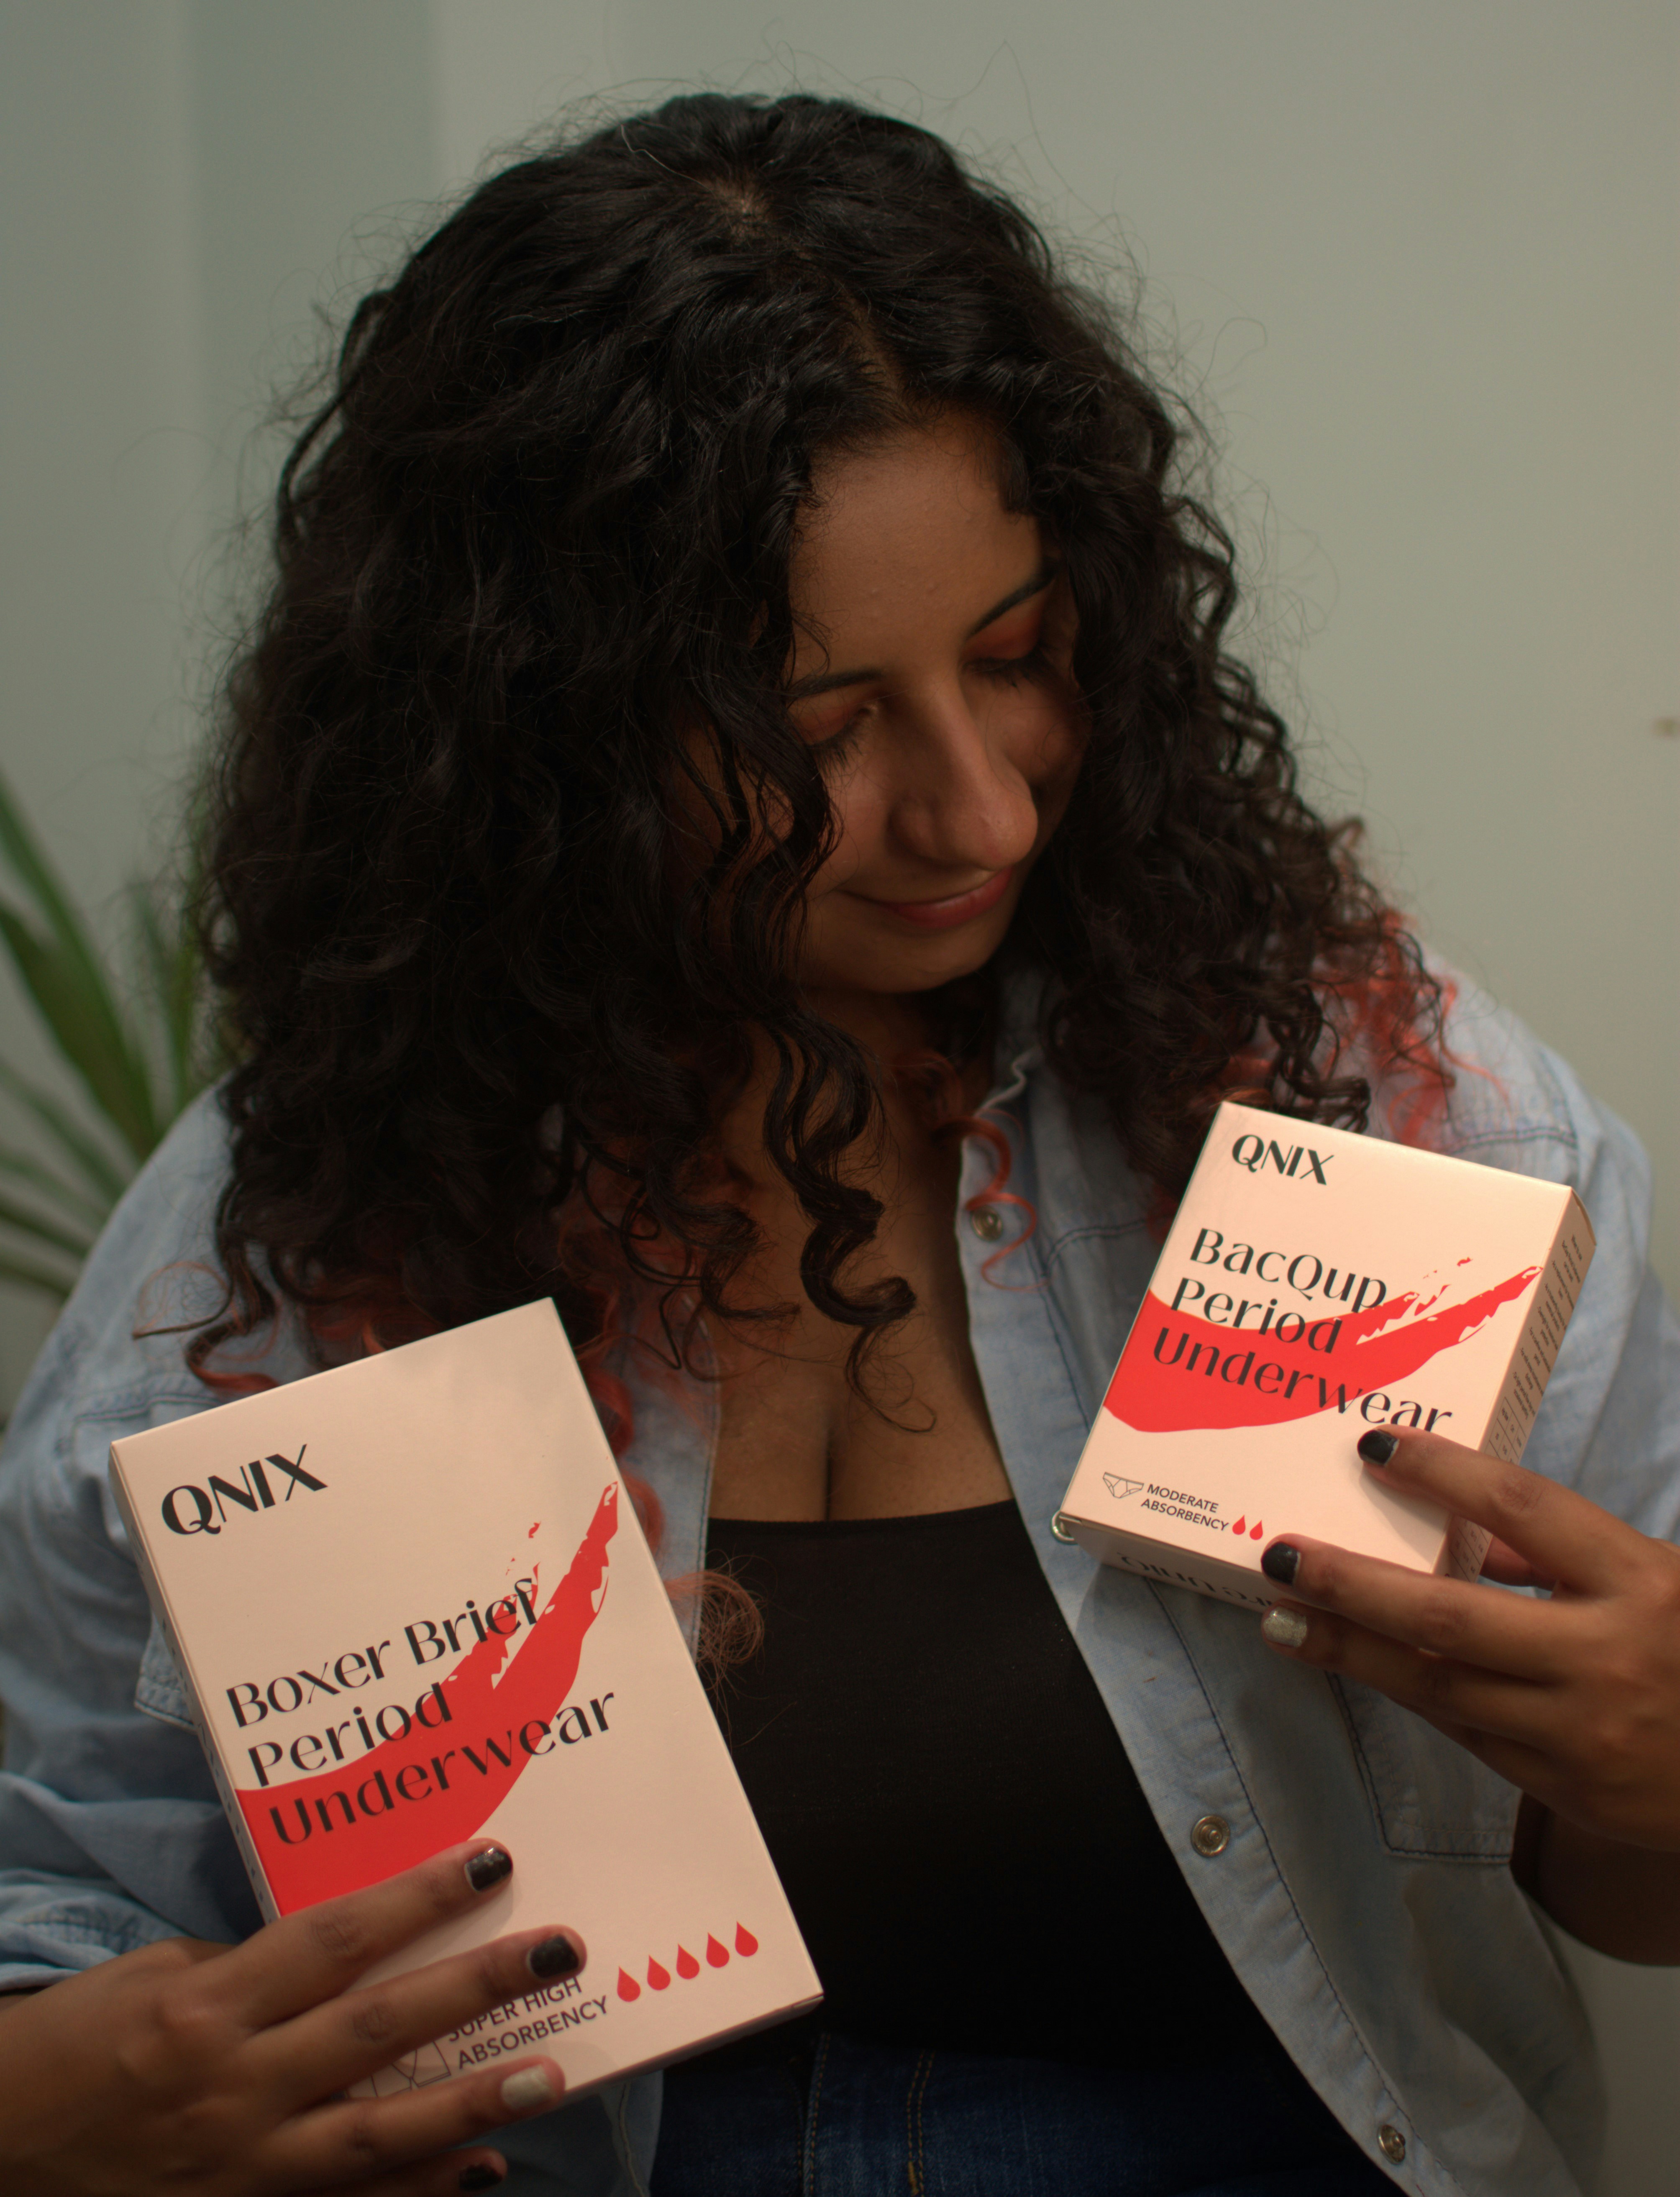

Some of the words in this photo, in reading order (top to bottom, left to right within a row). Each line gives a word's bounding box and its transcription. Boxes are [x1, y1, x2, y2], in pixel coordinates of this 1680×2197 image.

[1232, 1134, 1334, 1185] QNIX
[1190, 1228, 1387, 1313] BacQup
[1171, 1278, 1342, 1353] Period
[1153, 1327, 1452, 1432] Underwear
[161, 1444, 328, 1535] QNIX
[1141, 1499, 1229, 1531] ABSORBENCY
[1147, 1484, 1219, 1513] MODERATE
[226, 1641, 390, 1728] Boxer
[404, 1578, 537, 1665] Brief
[248, 1682, 452, 1787] Period
[269, 1692, 614, 1844] Underwear
[459, 1995, 607, 2069] ABSORBENCY
[522, 1977, 582, 2012] HIGH
